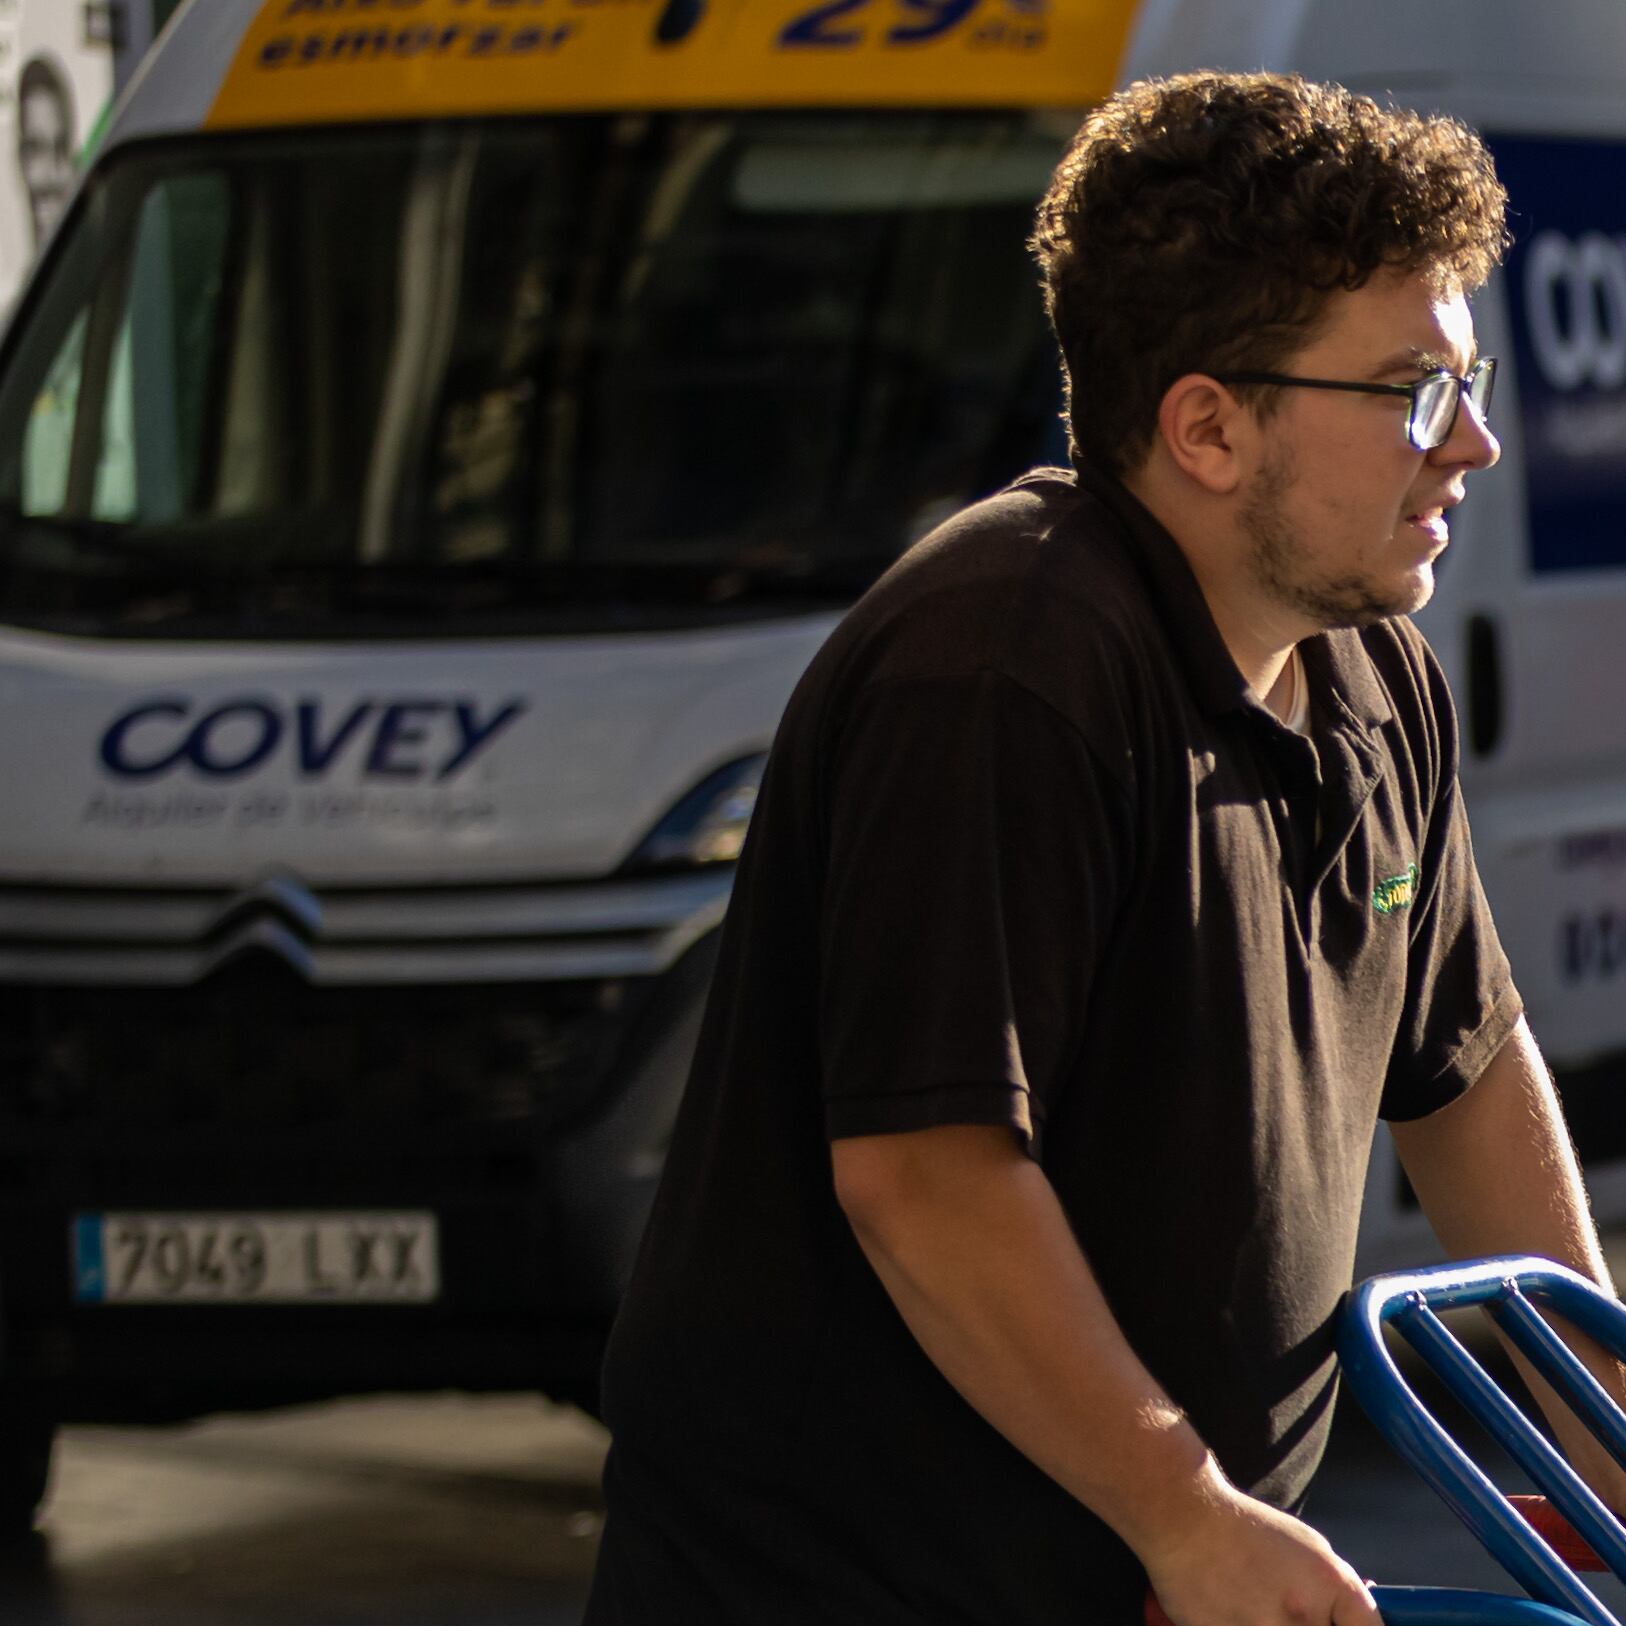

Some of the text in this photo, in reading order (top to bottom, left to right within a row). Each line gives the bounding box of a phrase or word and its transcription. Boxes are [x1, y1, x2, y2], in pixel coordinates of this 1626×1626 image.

[258, 22, 577, 70] esmorzar
[98, 697, 528, 782] COVEY
[114, 1222, 265, 1297] 7049
[303, 1224, 420, 1297] LXX
